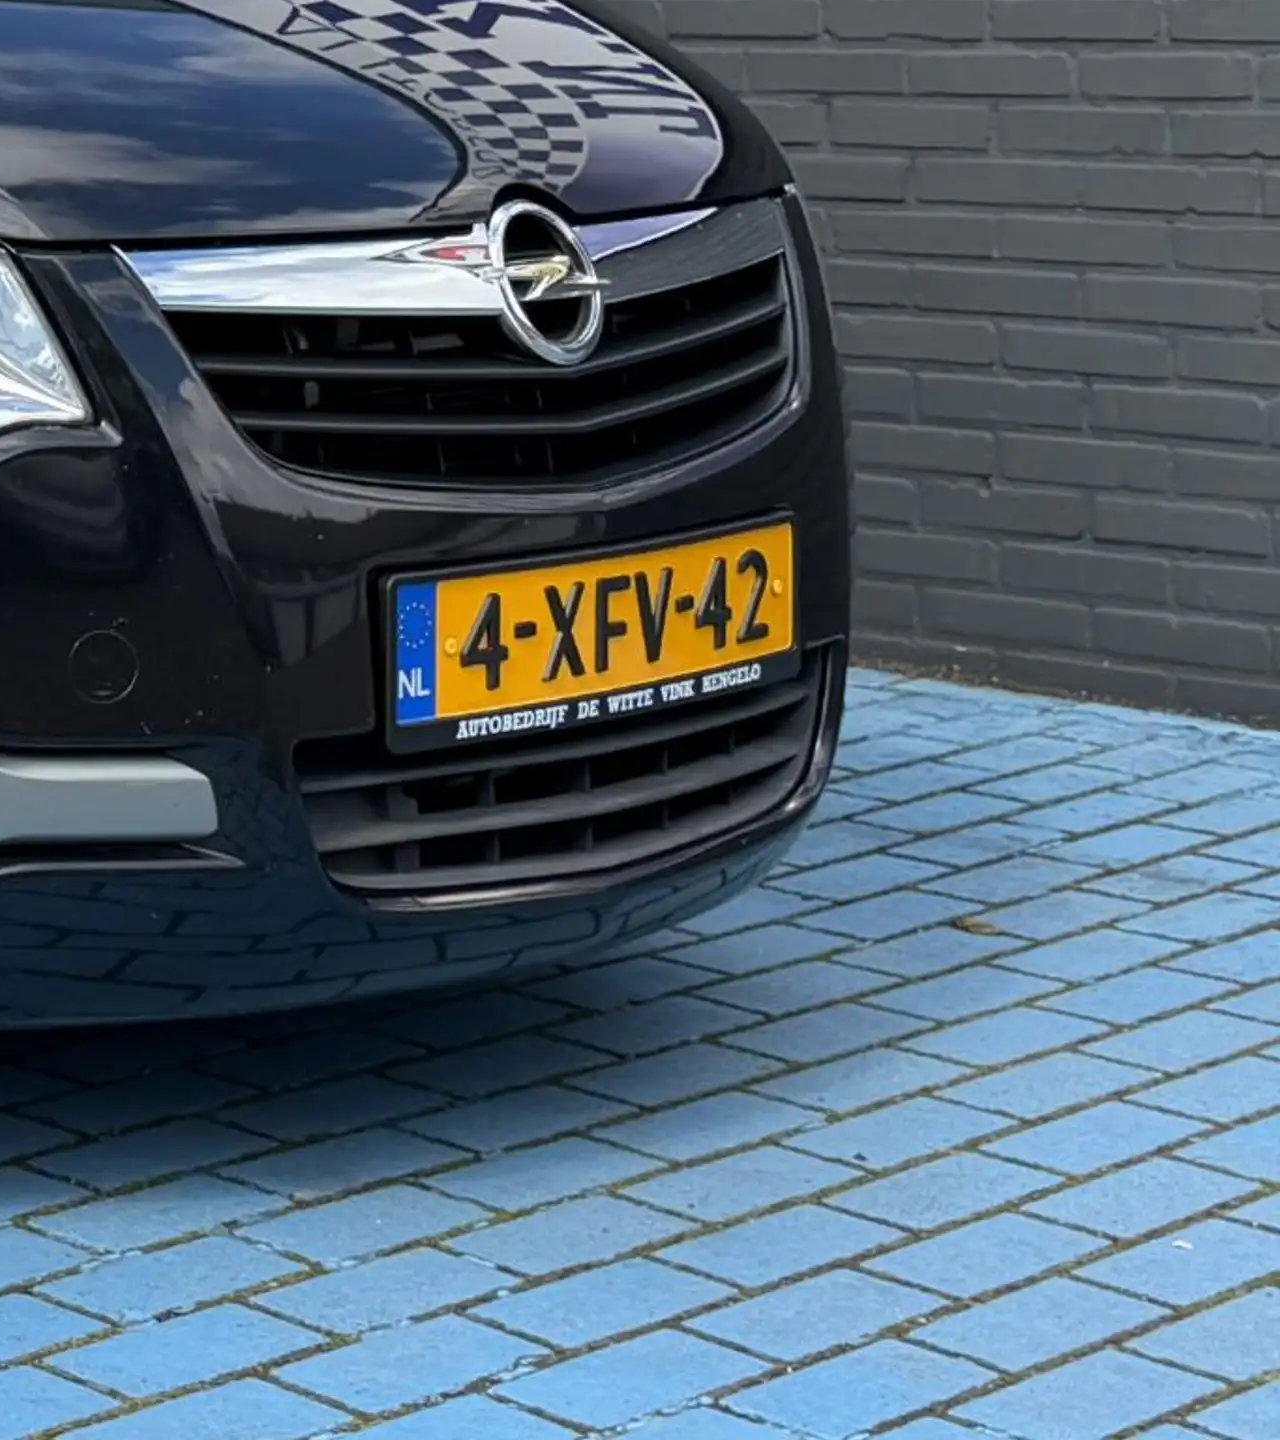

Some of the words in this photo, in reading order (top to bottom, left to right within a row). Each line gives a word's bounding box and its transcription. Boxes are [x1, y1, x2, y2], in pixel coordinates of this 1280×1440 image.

[458, 548, 770, 692] 4-XFV-42
[397, 667, 431, 700] NL
[455, 703, 569, 740] AUTOBEDRIJF
[577, 699, 600, 719] DE
[607, 686, 654, 715] WITTE
[660, 678, 696, 703] VINK
